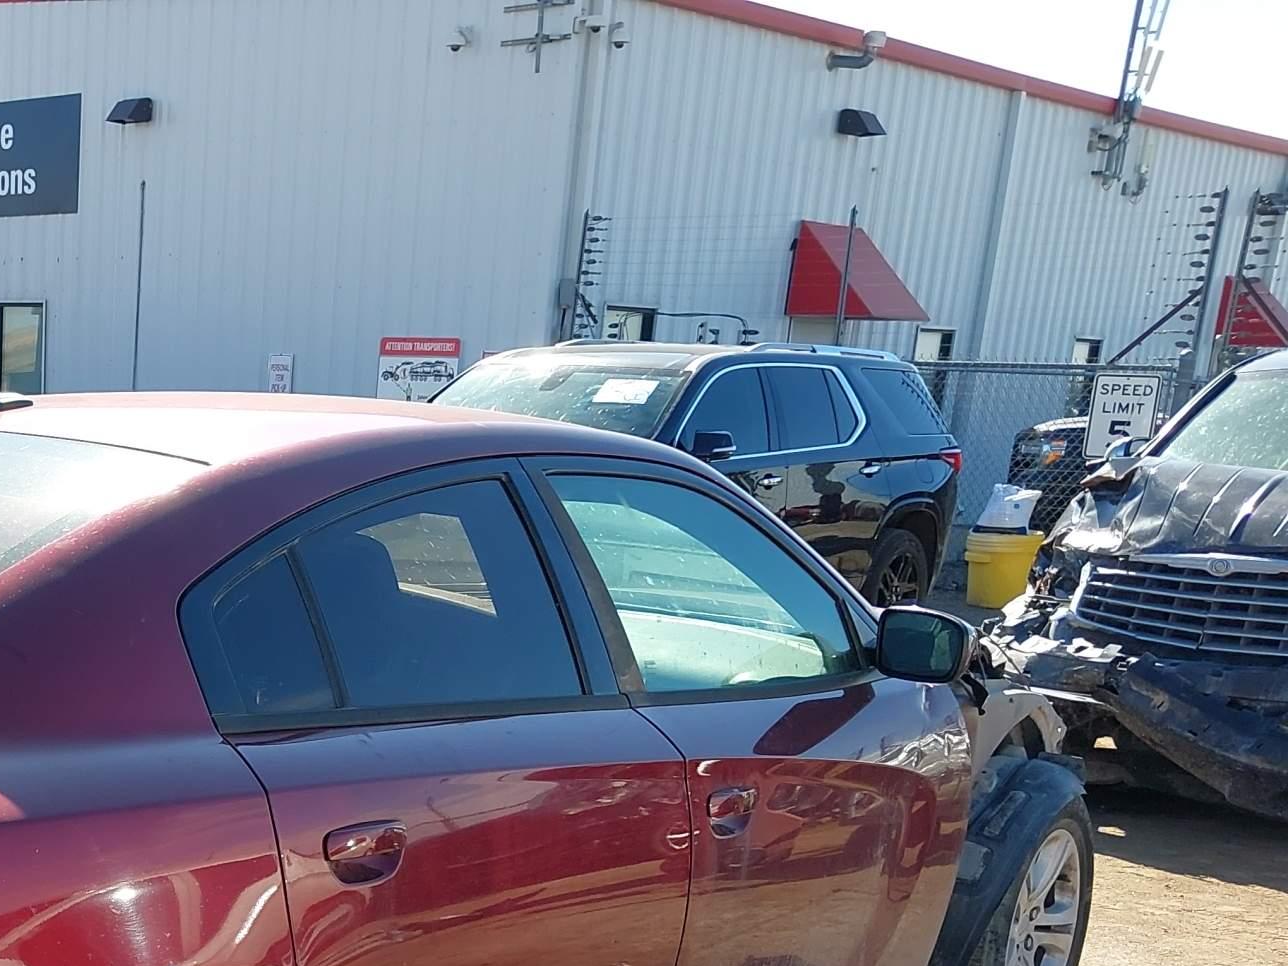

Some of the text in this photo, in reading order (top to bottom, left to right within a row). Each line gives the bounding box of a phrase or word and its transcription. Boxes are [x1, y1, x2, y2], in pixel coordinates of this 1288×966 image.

[384, 341, 413, 351] ATTENTION
[1100, 383, 1154, 397] SPEED
[1102, 402, 1145, 415] LIMIT
